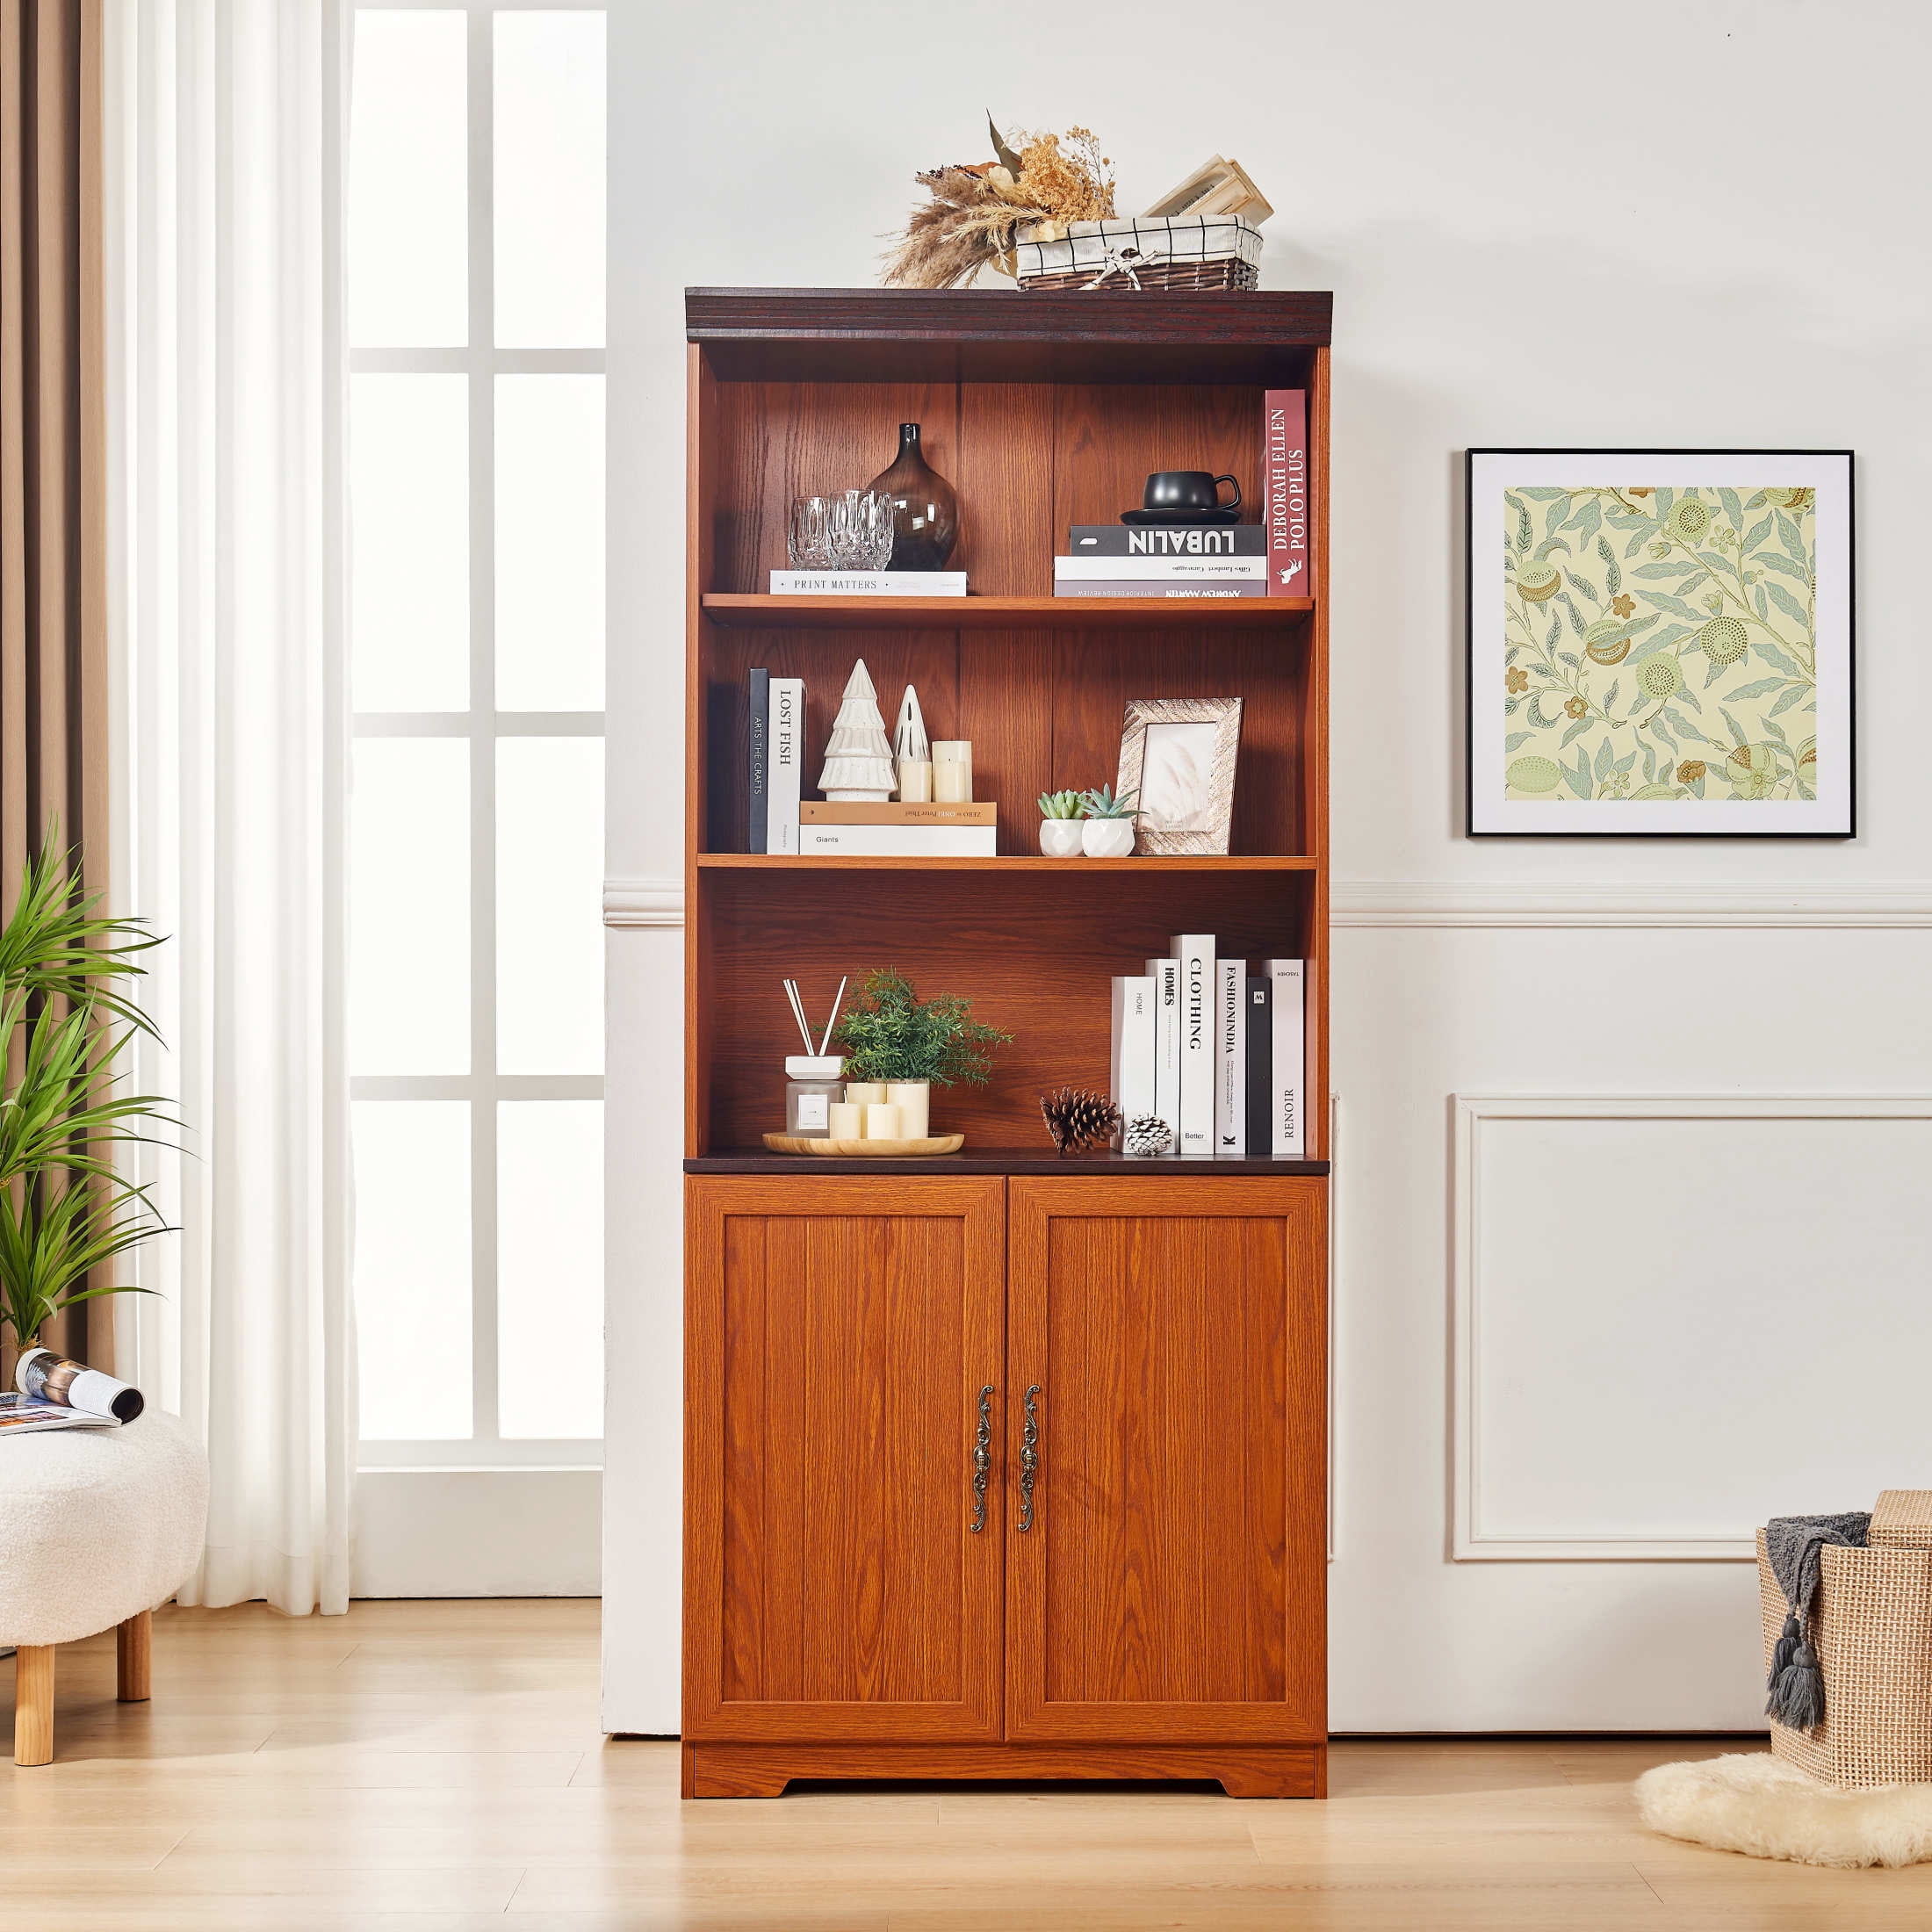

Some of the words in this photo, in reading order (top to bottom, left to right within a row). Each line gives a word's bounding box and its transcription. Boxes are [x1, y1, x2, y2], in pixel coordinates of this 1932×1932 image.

[1271, 408, 1286, 462] ELLEN
[1288, 449, 1304, 494] PLUS
[1272, 467, 1287, 551] DEBORAH
[1289, 498, 1305, 550] POLO
[1128, 530, 1235, 554] LUBALIN
[794, 580, 826, 589] PRINT
[831, 580, 877, 589] MATTERS
[753, 717, 762, 739] ARTS
[780, 689, 791, 728] LOST
[753, 742, 762, 760] THE
[780, 732, 791, 766] FISH
[753, 763, 762, 795] CRAFTS
[1164, 967, 1175, 1006] HOMES
[1189, 957, 1202, 1050] CLOTHING
[1225, 967, 1236, 1054] FASHIONINDIA
[1284, 1088, 1294, 1139] RENOIR
